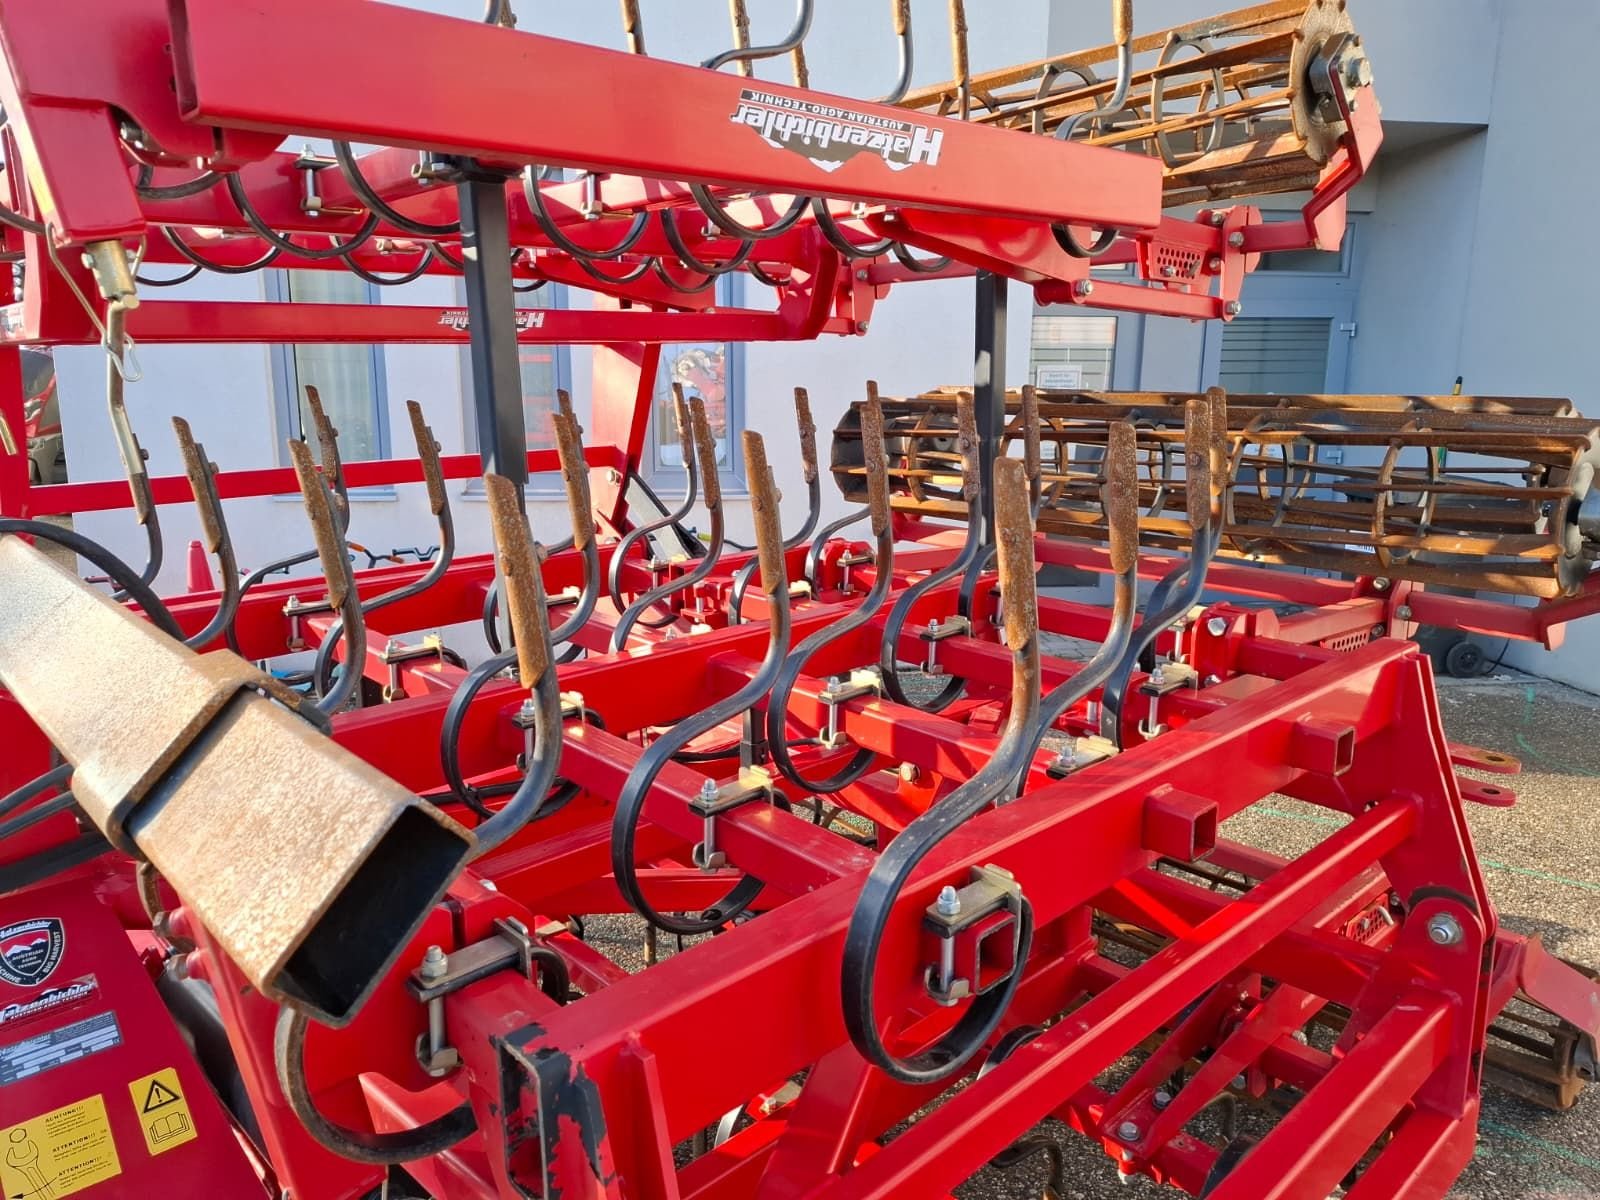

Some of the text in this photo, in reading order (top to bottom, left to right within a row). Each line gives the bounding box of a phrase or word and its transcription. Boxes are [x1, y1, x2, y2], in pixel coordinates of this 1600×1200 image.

[751, 91, 904, 130] AUSTRIAN-AGRO-TECHNIK
[730, 104, 943, 166] Hatzenbichler
[53, 1132, 96, 1152] ATTENTION!!!
[58, 1155, 102, 1176] ATTENTION!!!
